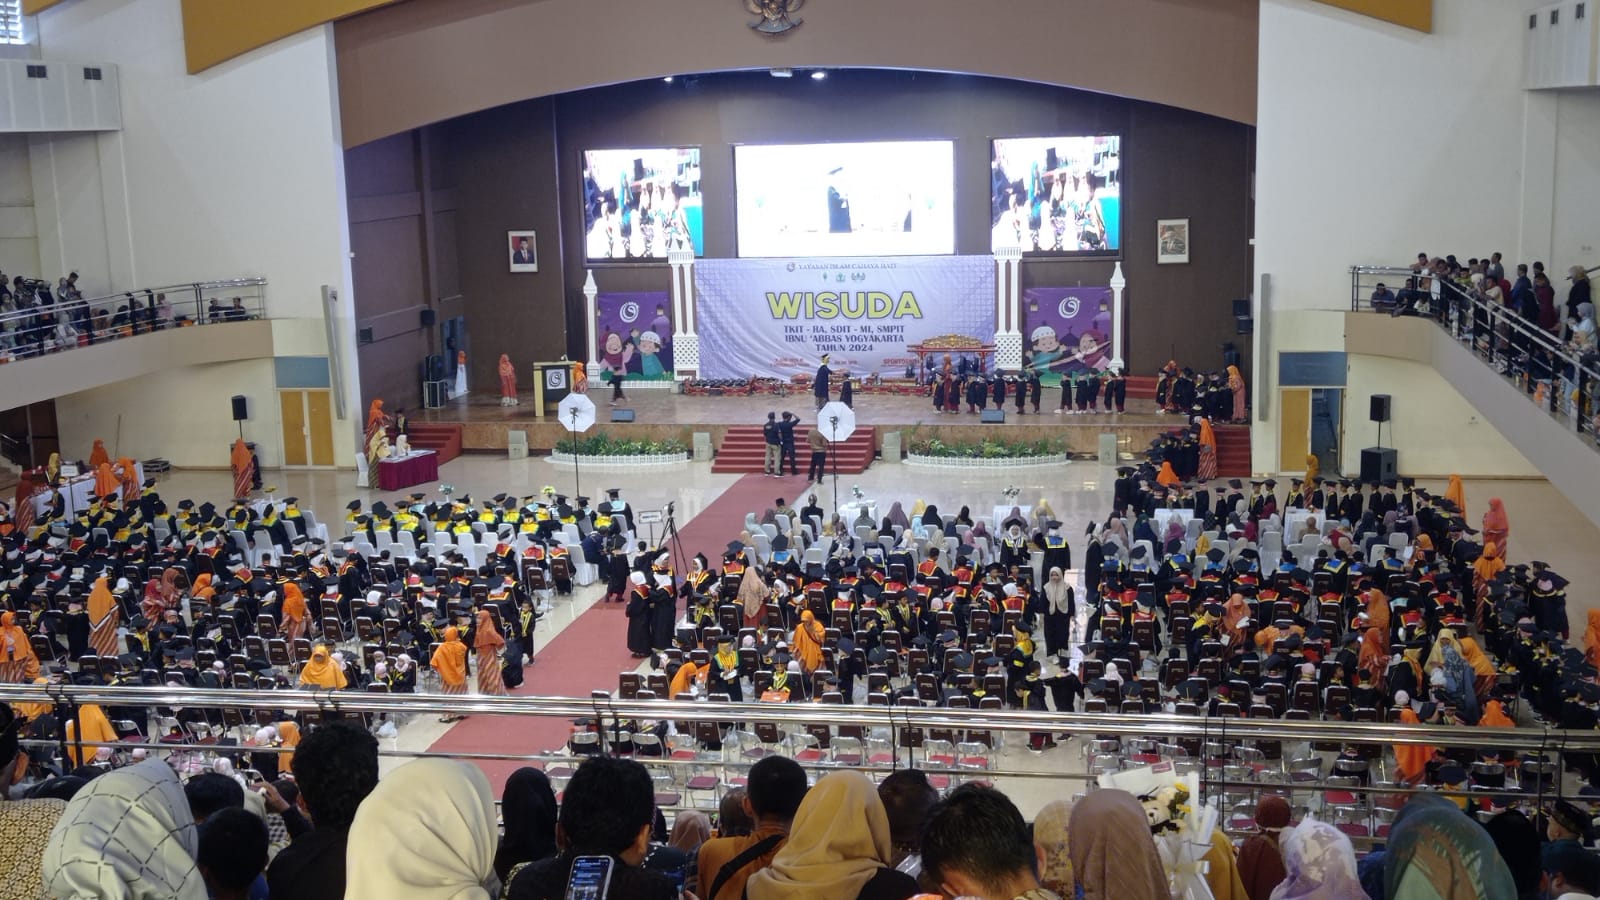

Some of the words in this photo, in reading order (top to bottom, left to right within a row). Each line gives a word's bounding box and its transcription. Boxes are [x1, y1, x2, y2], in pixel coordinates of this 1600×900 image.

[765, 291, 923, 320] WISUDA
[784, 325, 804, 334] TKIT
[812, 325, 828, 335] RA,
[830, 325, 851, 334] SDIT
[859, 325, 874, 335] MI,
[876, 325, 905, 334] SMPIT
[785, 334, 807, 343] IBNU
[846, 334, 904, 343] YOGYAKARTA
[816, 344, 846, 352] TAHUN
[848, 344, 873, 352] 2024
